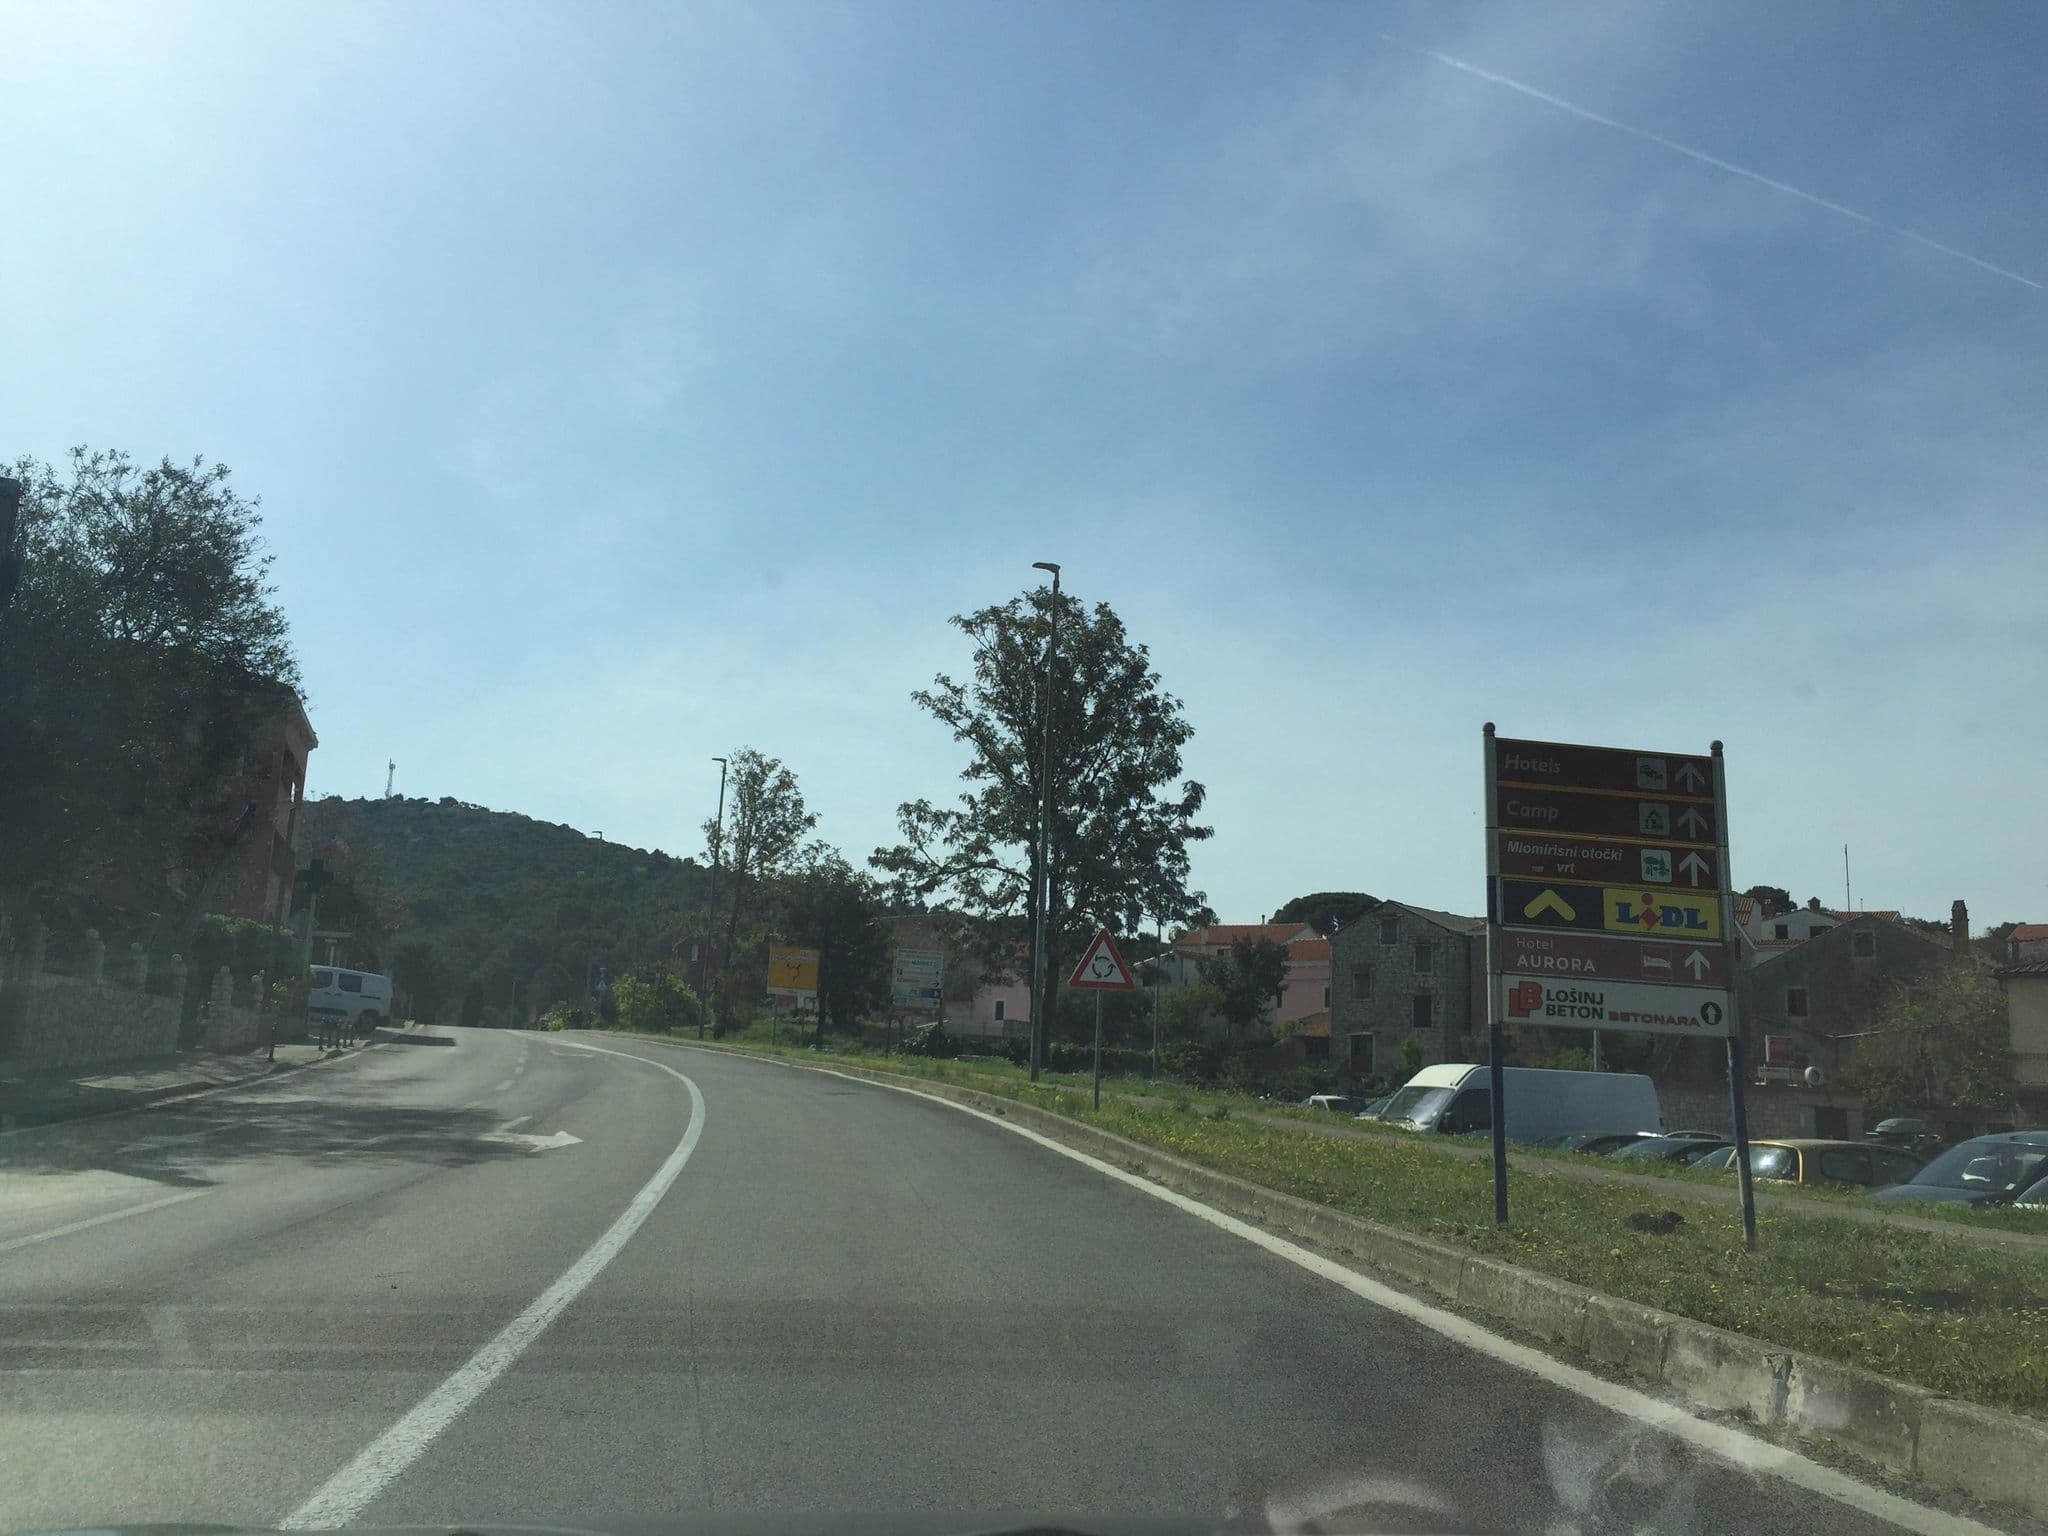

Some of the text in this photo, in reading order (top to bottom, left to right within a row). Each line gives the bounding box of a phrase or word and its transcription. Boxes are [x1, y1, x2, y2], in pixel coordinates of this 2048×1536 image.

[1504, 752, 1561, 774] Hotels
[1506, 800, 1560, 823] Camp
[1556, 863, 1576, 874] vrt
[1516, 937, 1553, 950] Hotel
[1516, 954, 1596, 973] AURORA
[1546, 987, 1604, 1005] LOŠINJ
[1545, 1005, 1604, 1020] BETON
[1607, 1010, 1701, 1027] BETONARA
